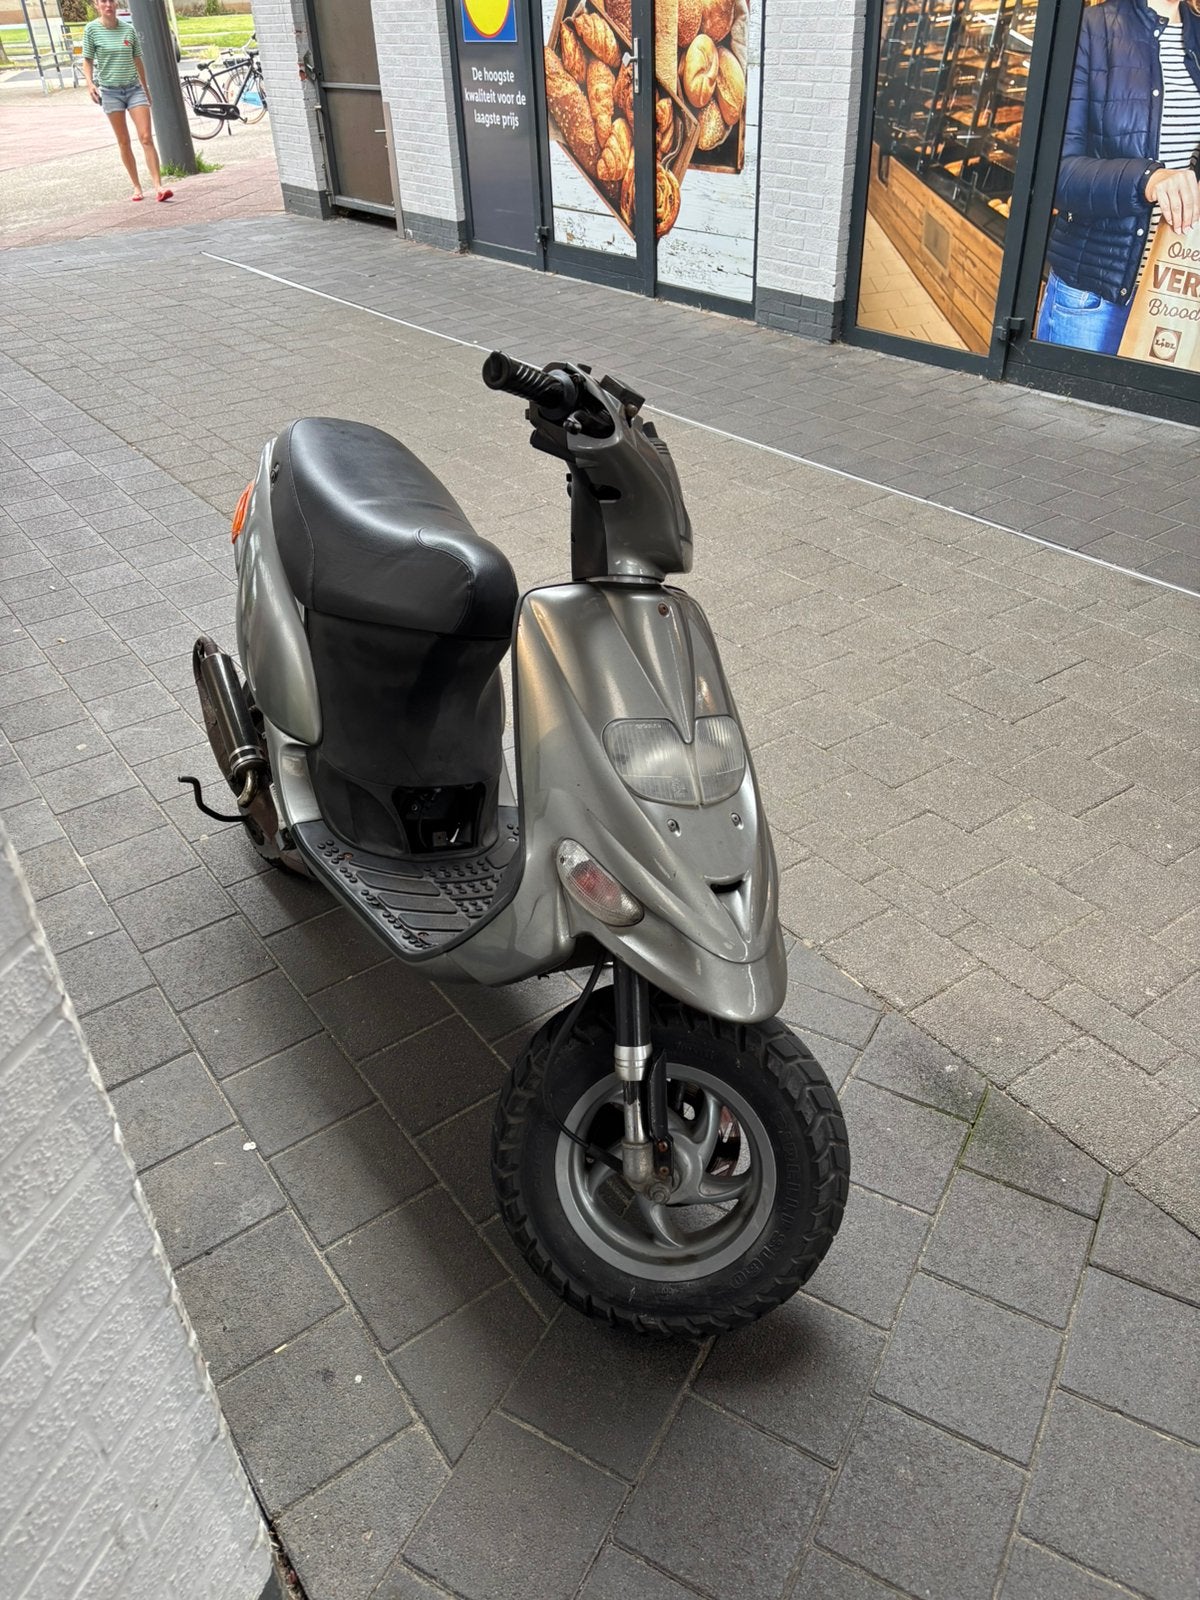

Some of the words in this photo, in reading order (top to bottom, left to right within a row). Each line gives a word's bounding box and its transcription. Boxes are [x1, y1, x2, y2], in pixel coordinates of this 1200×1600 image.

[472, 67, 482, 81] De
[483, 67, 515, 85] hoogste
[465, 88, 496, 103] kwaliteit
[496, 92, 515, 105] voor
[516, 91, 526, 105] de
[474, 109, 501, 127] laagste
[502, 112, 520, 130] prijs
[1168, 241, 1200, 262] Ove
[1153, 264, 1200, 298] VER
